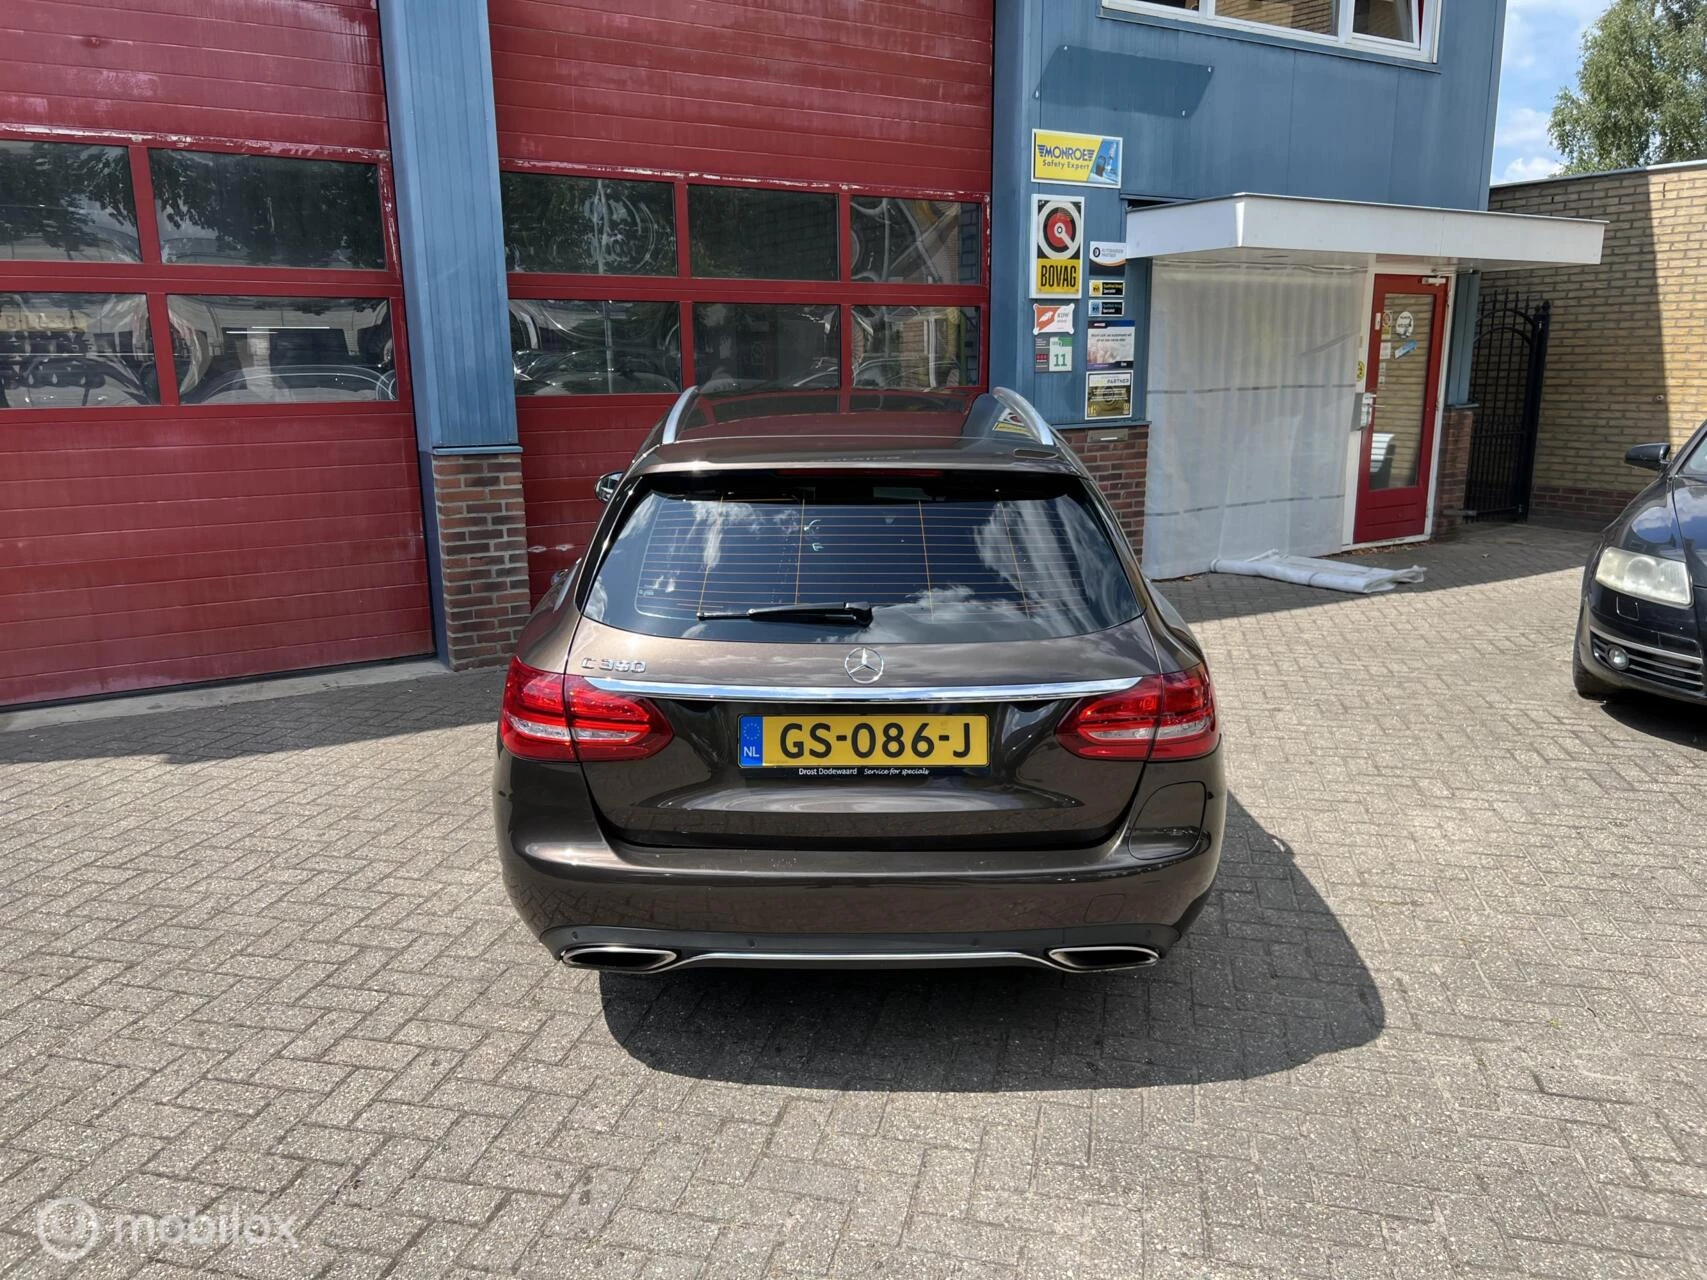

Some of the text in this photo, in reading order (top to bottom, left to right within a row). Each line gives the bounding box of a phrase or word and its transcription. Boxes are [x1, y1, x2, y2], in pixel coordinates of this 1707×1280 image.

[1042, 145, 1089, 162] MONROE
[1042, 159, 1090, 171] Safety Expert
[1040, 265, 1077, 288] BOVAG
[1053, 353, 1068, 367] 11
[581, 657, 595, 669] C
[780, 722, 972, 759] GS-086-J
[743, 746, 760, 757] NL
[888, 768, 900, 776] for
[901, 768, 929, 776] specials
